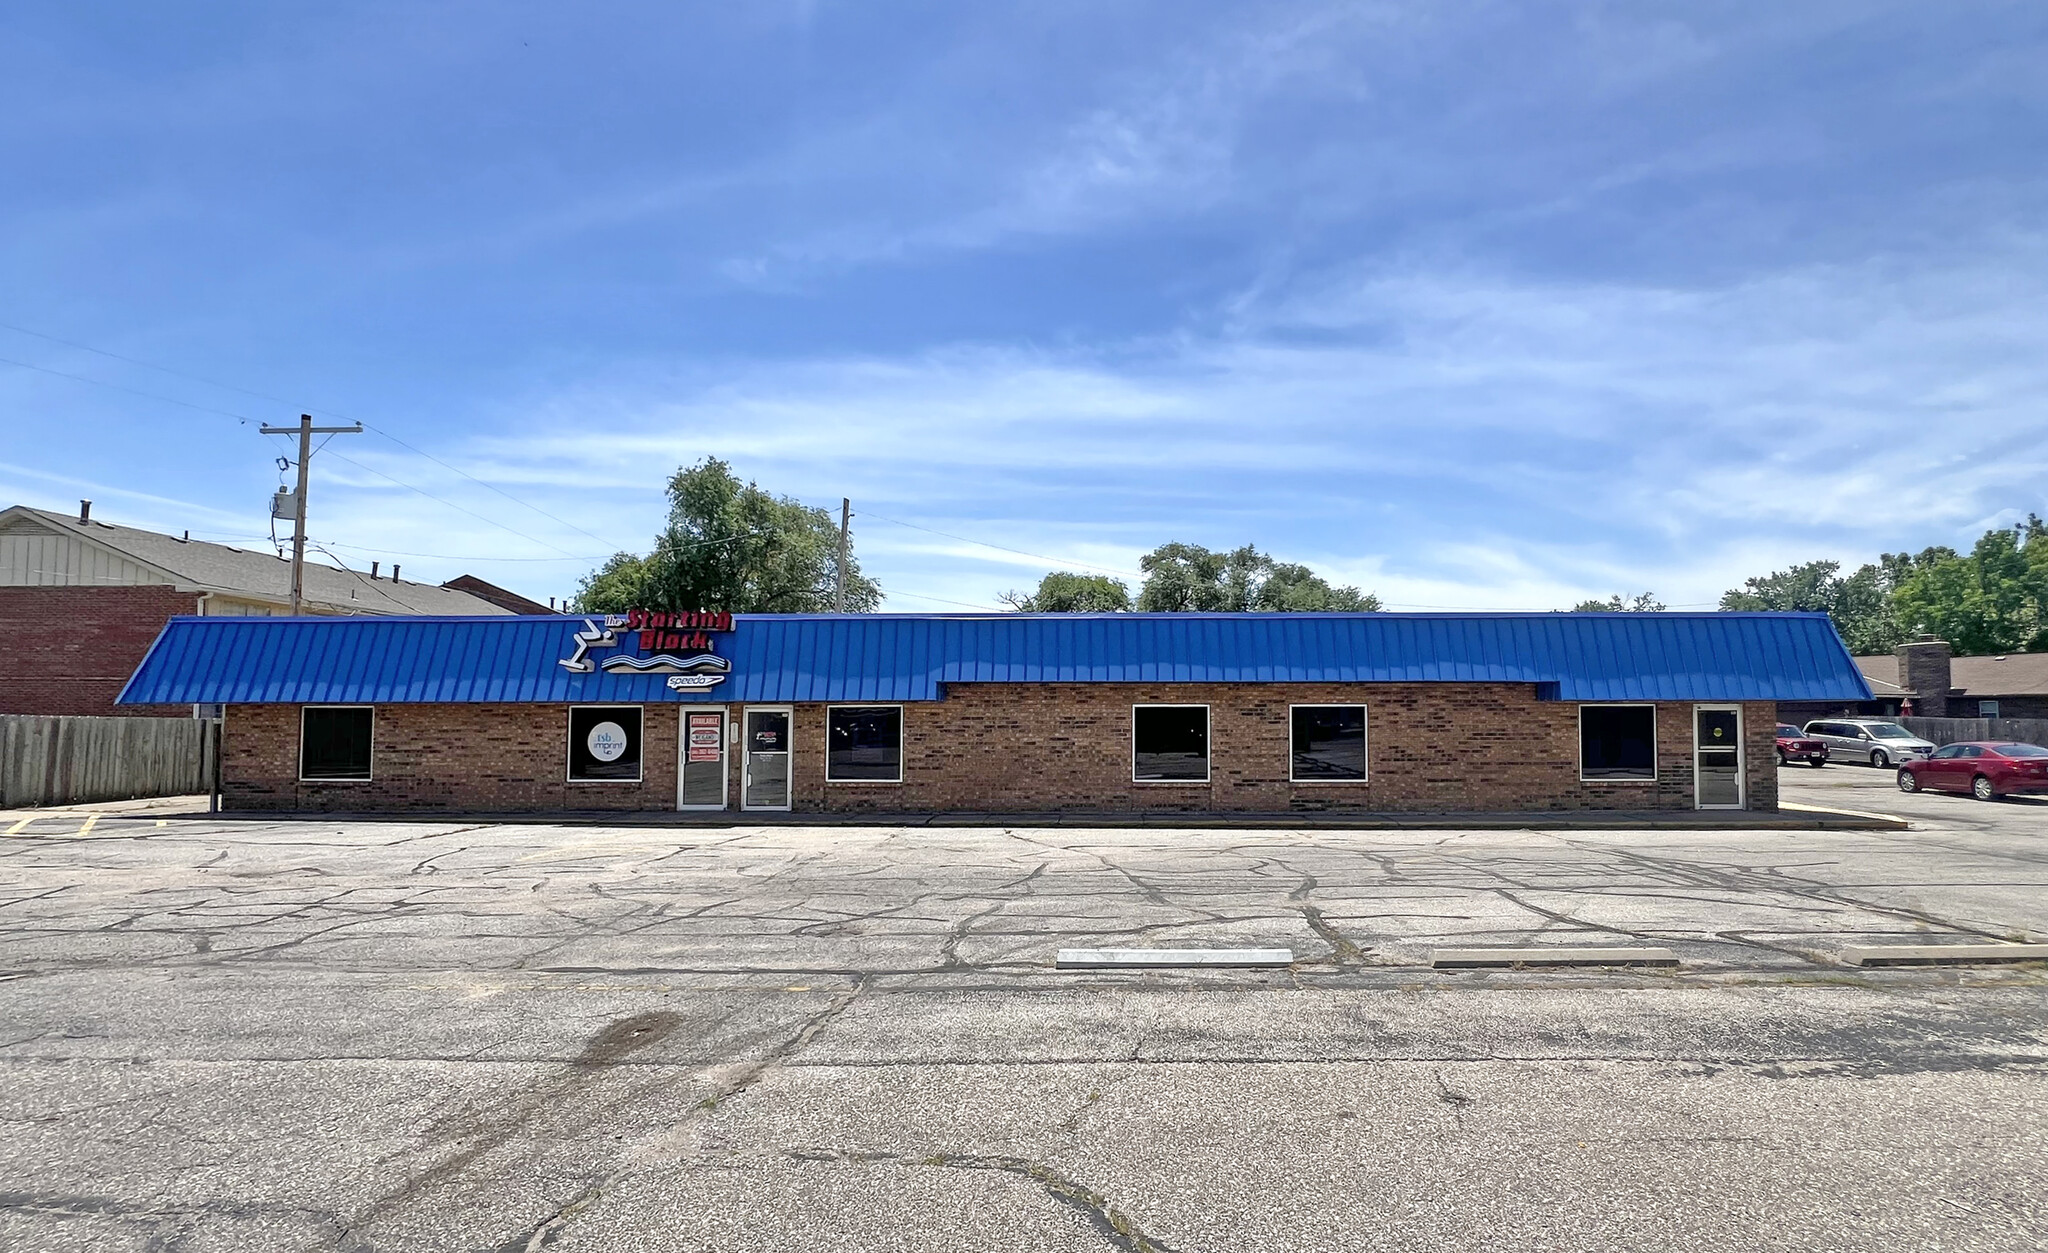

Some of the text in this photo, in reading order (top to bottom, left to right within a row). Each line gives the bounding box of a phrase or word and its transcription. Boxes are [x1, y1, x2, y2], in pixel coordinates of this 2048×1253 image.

[604, 609, 731, 630] The Starting
[640, 631, 707, 650] Block
[669, 674, 706, 686] speedo
[692, 717, 718, 725] AVAILABLE
[593, 741, 623, 755] imprint
